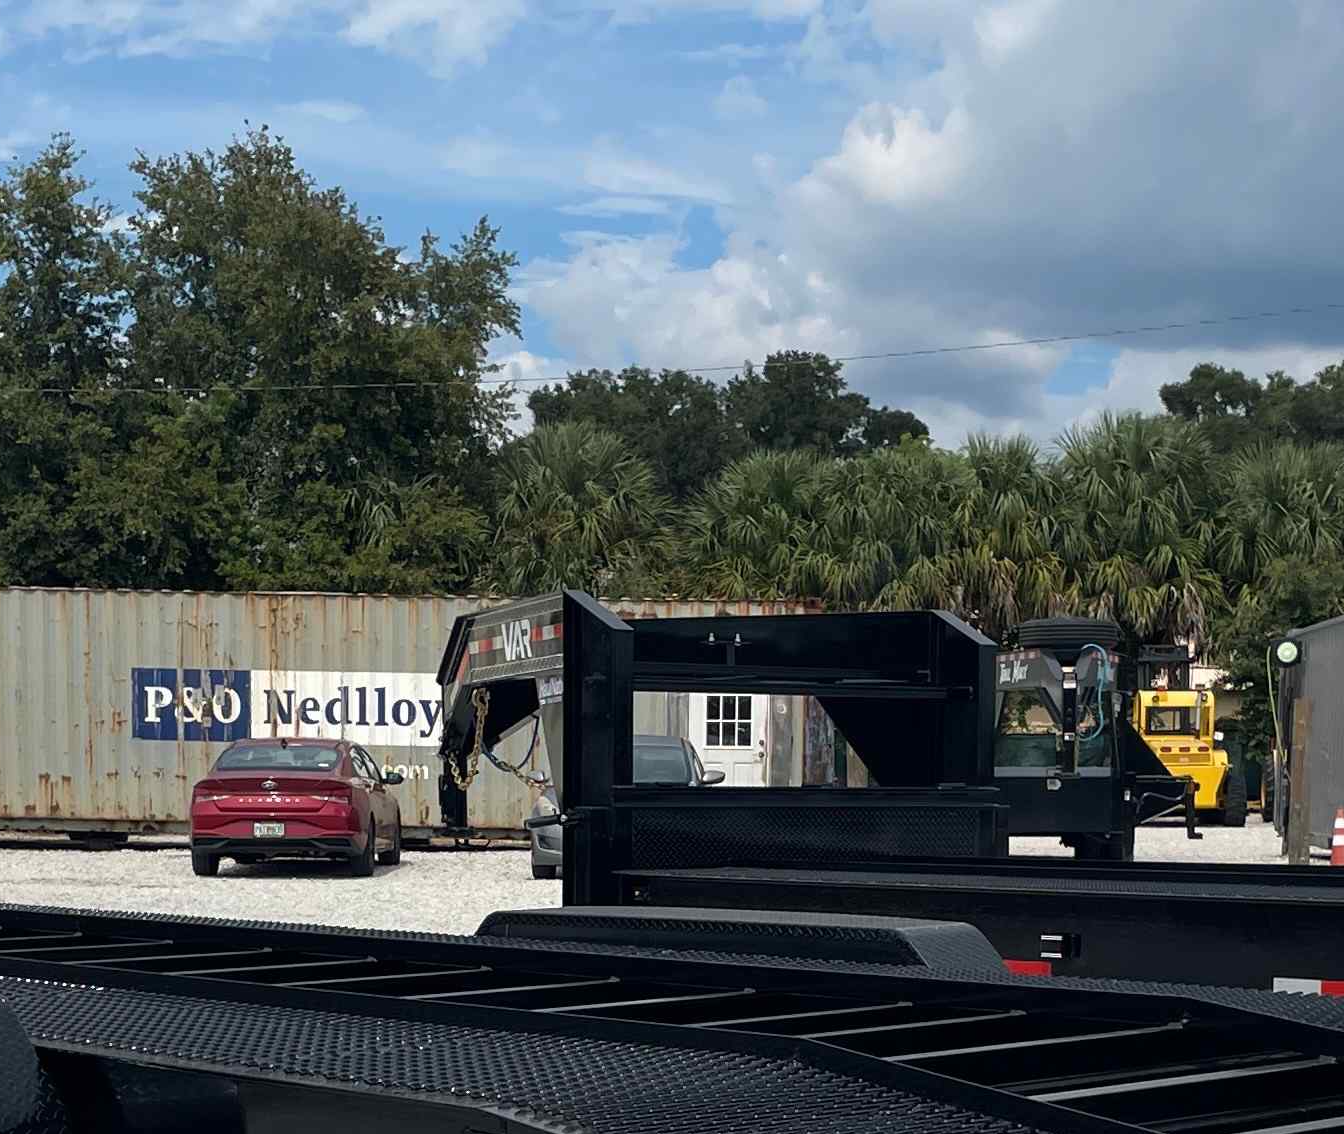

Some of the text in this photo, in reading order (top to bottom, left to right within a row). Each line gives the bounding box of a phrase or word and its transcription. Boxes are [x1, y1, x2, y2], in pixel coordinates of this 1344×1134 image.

[501, 619, 532, 661] VAR
[144, 685, 443, 738] P&O Nedlloy
